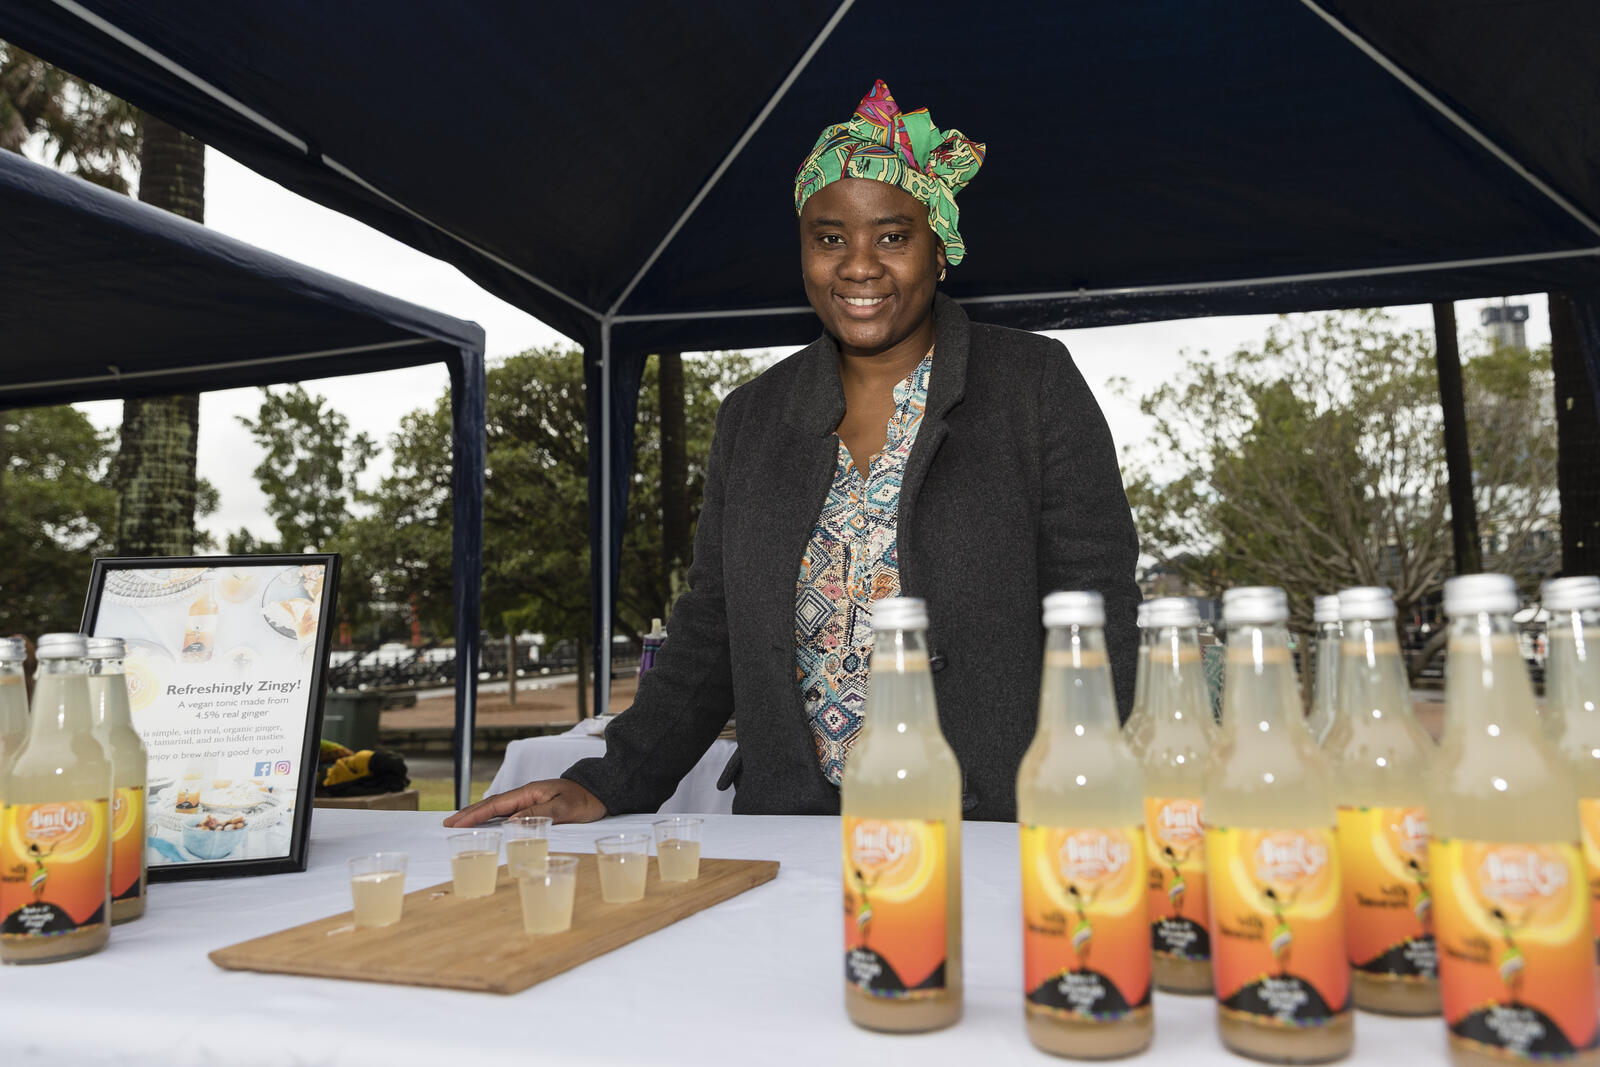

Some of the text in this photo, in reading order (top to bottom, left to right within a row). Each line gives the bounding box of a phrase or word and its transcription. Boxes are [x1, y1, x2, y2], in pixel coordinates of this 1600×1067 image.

[166, 679, 301, 696] Refreshingly Zingy!
[178, 696, 289, 710] A vegan tonic made from
[195, 709, 269, 720] 4.5% real ginger
[143, 730, 150, 738] is
[184, 727, 202, 735] with
[204, 726, 221, 735] real,
[223, 726, 254, 735] organic
[255, 723, 283, 733] ginger,
[196, 735, 212, 744] and
[226, 734, 254, 743] hidden
[149, 750, 171, 761] enjoy
[181, 751, 201, 759] brew
[227, 747, 249, 758] good
[252, 746, 264, 755] for
[265, 745, 284, 755] you!
